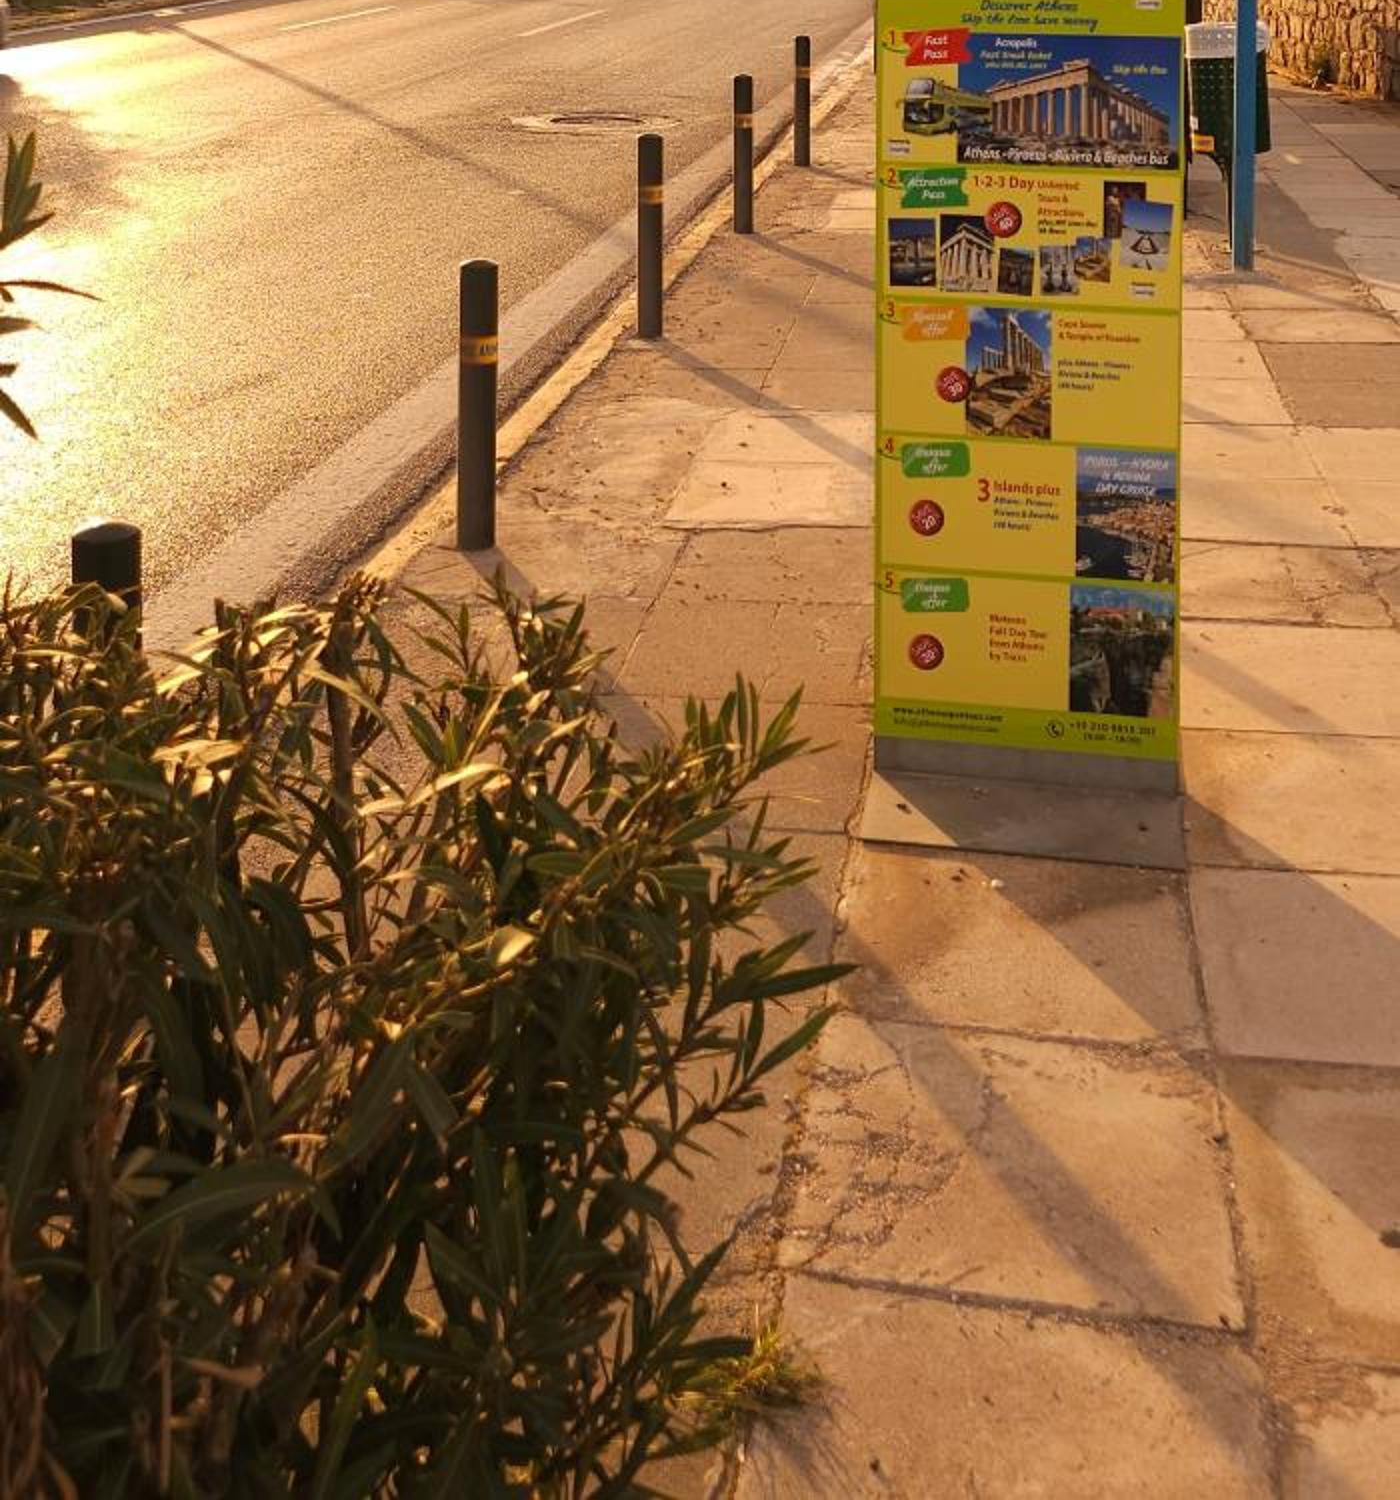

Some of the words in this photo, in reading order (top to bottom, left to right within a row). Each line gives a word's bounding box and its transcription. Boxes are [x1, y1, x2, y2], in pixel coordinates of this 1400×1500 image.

[980, 0, 1032, 11] Discover
[1034, 0, 1079, 11] Athens
[925, 35, 949, 46] Fast
[994, 37, 1038, 49] Acropolis
[923, 49, 949, 61] Pass
[963, 147, 1001, 160] Athens
[1104, 151, 1147, 168] Beaches
[1149, 152, 1169, 166] bus
[887, 168, 897, 185] 2
[906, 177, 959, 190] Attraction
[1008, 176, 1036, 193] Day
[921, 190, 946, 200] Pass
[886, 301, 895, 317] 3
[884, 438, 894, 454] 4
[976, 478, 991, 503] 3
[992, 480, 1034, 495] Islands
[1035, 484, 1061, 498] plus
[1096, 483, 1118, 494] DAY
[885, 572, 894, 589] 5
